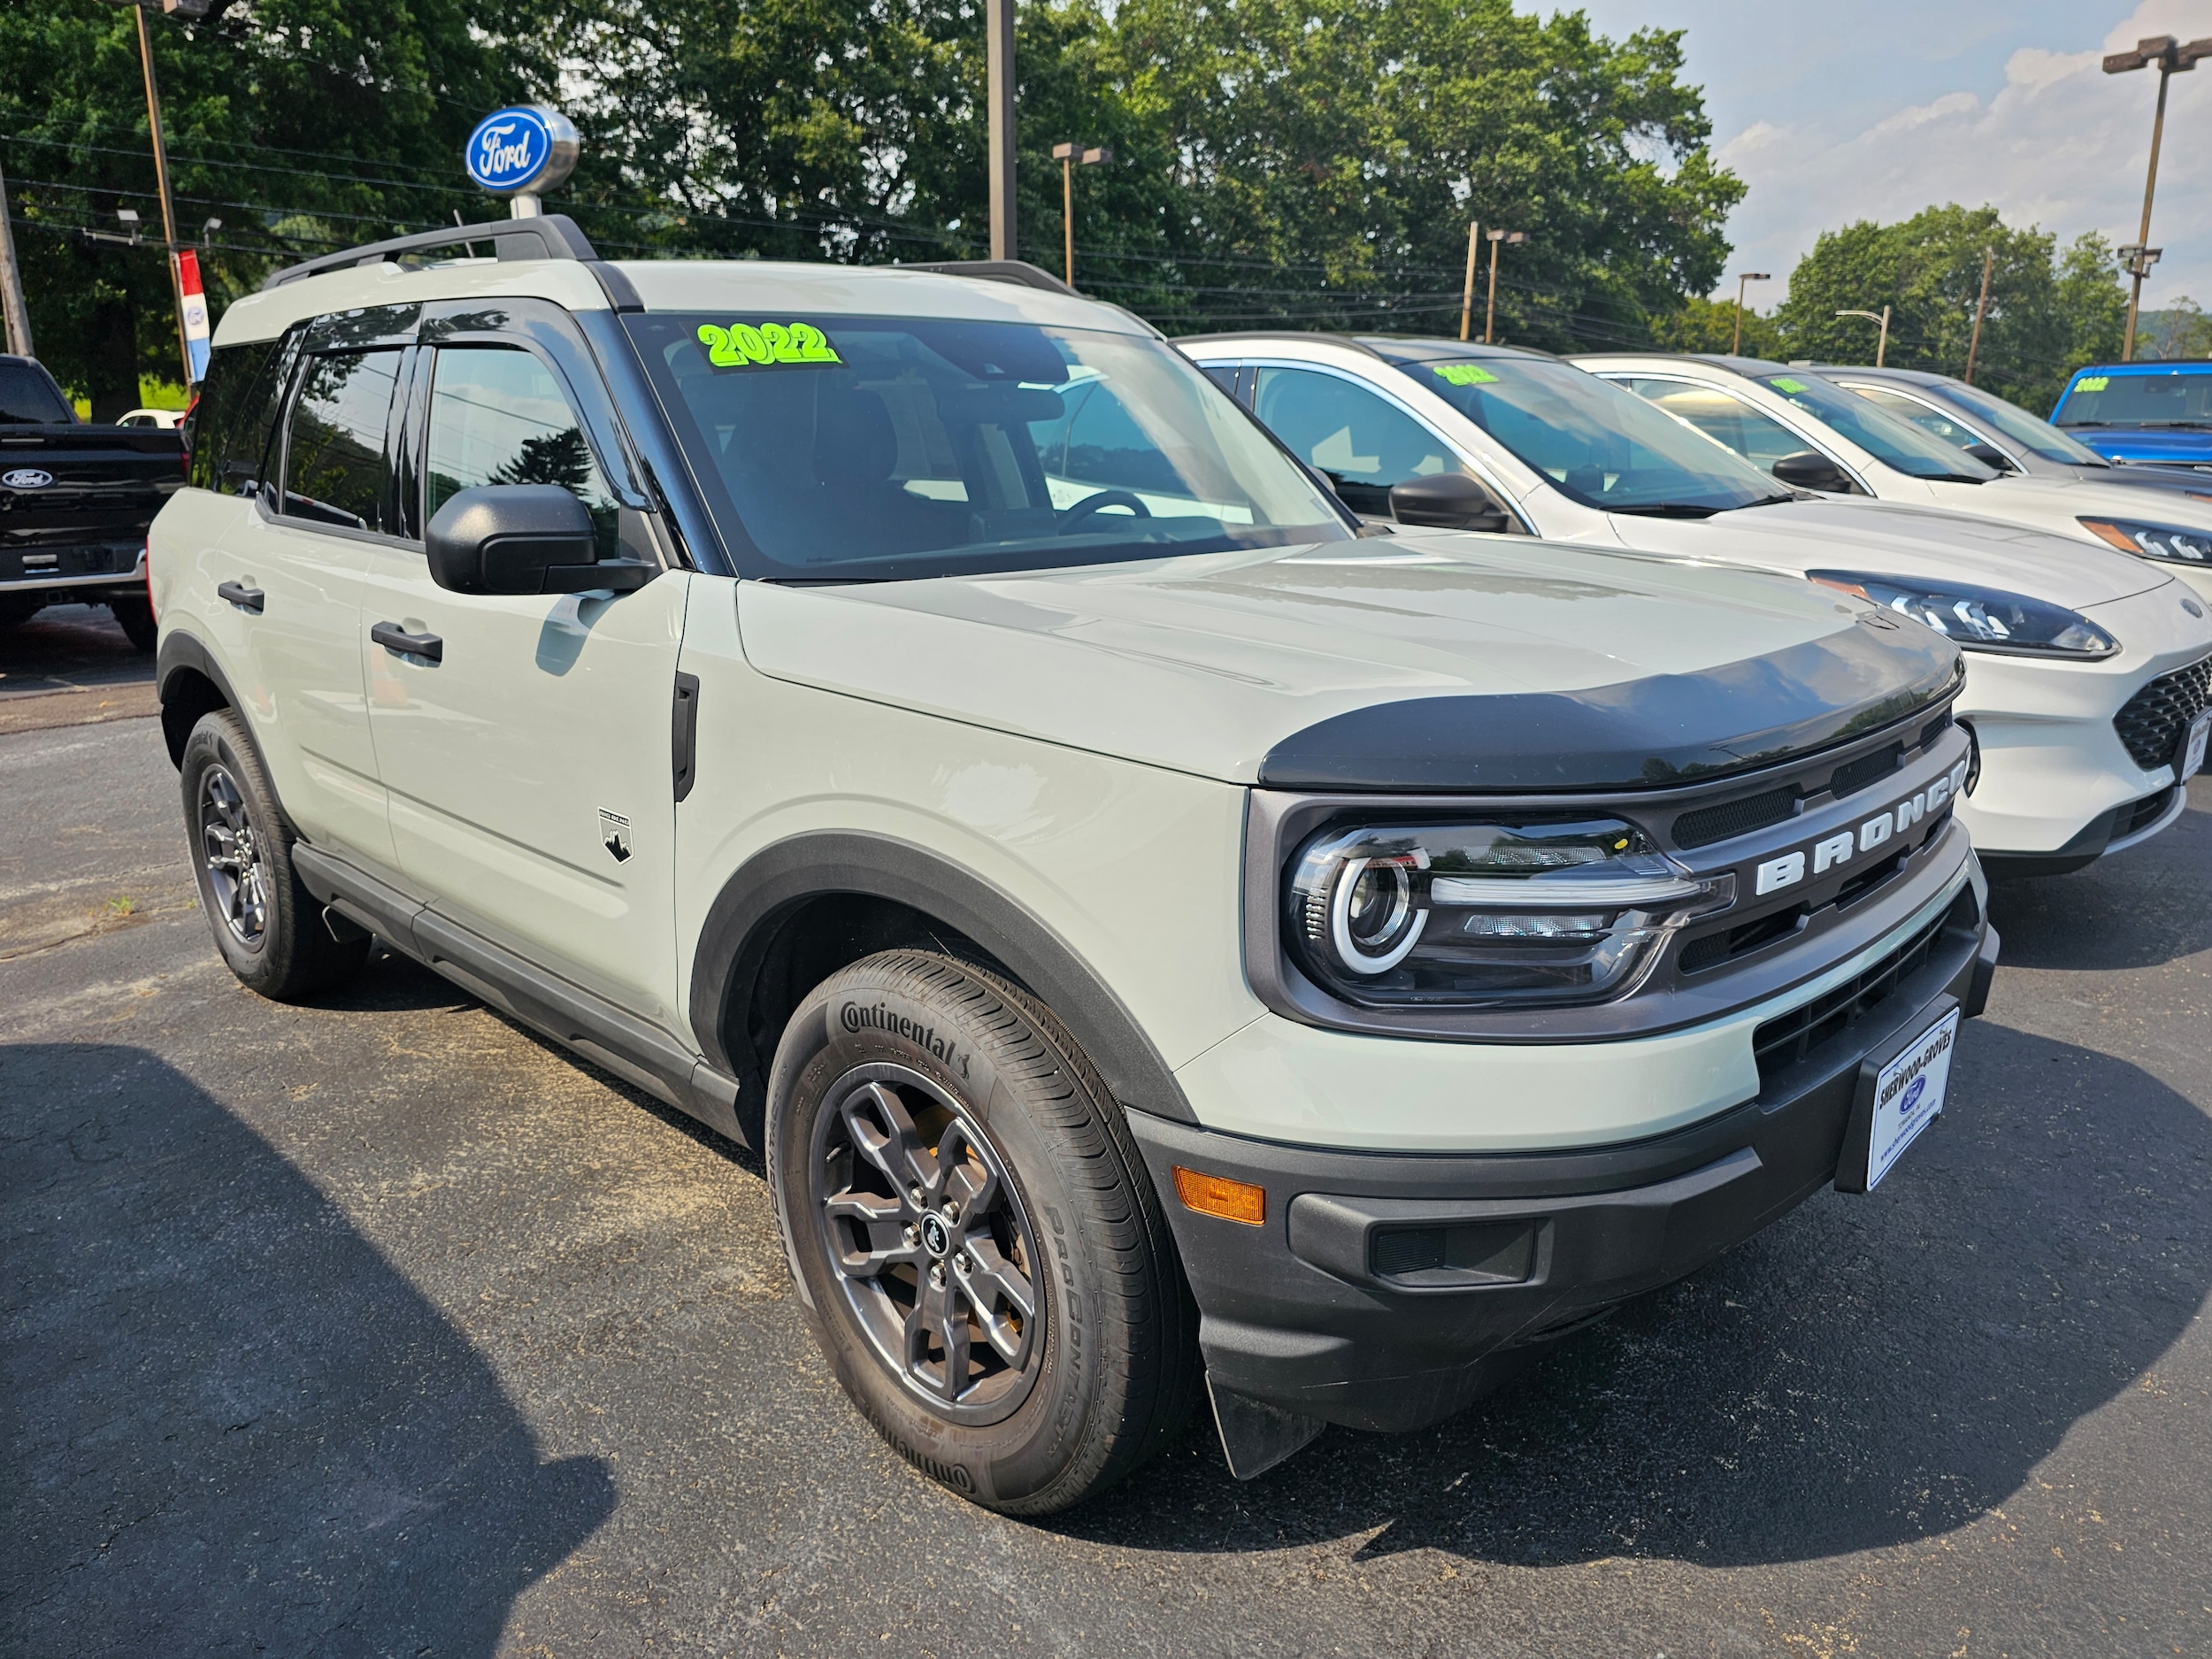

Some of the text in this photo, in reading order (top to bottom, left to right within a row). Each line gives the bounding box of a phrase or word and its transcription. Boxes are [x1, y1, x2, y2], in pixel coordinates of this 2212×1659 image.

[479, 123, 531, 177] Ford
[697, 322, 843, 367] 2022
[11, 472, 44, 485] Ford
[1755, 760, 1966, 896] BRONCO
[841, 1000, 956, 1067] Continental
[1878, 1028, 1952, 1110] SHERWOOD-GROVES
[1902, 1080, 1922, 1110] Ford
